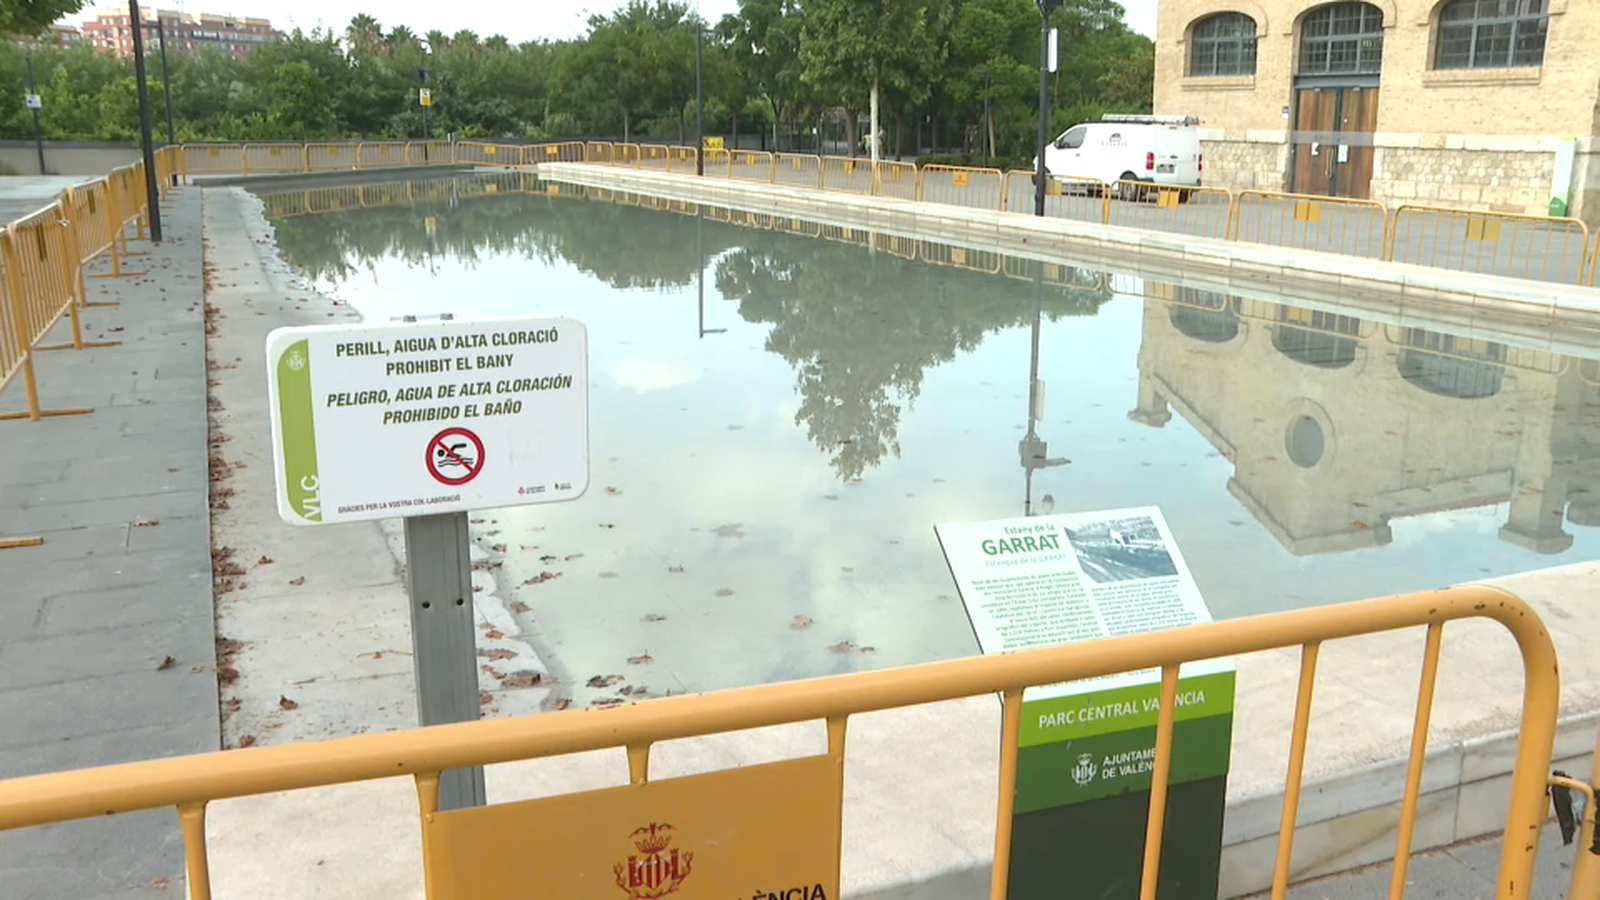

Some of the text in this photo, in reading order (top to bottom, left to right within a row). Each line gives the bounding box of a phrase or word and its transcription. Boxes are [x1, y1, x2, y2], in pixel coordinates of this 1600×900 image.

[336, 327, 559, 358] PERILL, AIGUA D'ALTA CLORACIÓ
[386, 354, 513, 377] PROHIBIT EL BANY
[326, 374, 572, 408] PELIGRO, AGUA DE ALTA CLORACIÓN
[383, 399, 523, 425] PROHIBIDO EL BAÑO
[301, 474, 321, 519] VLC
[366, 503, 378, 511] PER
[379, 502, 388, 510] LA
[1035, 524, 1046, 533] de
[1046, 523, 1055, 531] la
[981, 534, 1061, 556] GARRAT
[1039, 690, 1207, 730] PARC CENTRAL VANCIA
[1103, 748, 1157, 767] AJUNTAME
[1102, 760, 1157, 780] DE VALÈN
